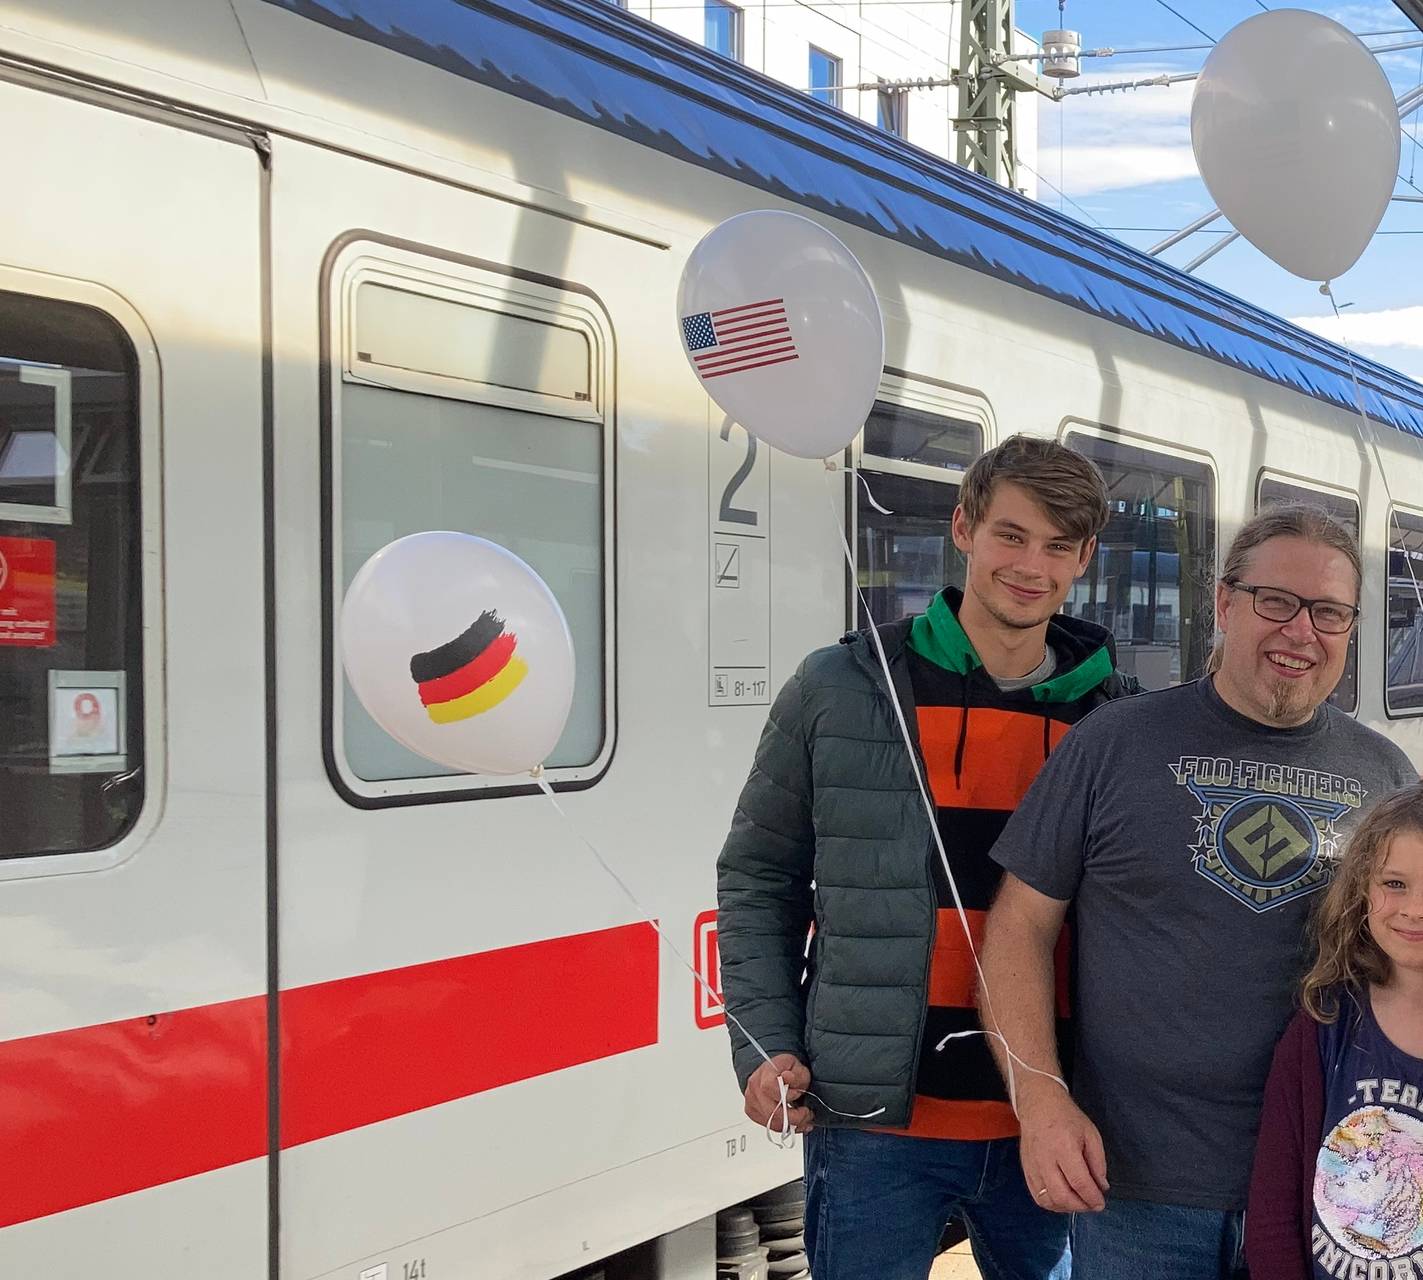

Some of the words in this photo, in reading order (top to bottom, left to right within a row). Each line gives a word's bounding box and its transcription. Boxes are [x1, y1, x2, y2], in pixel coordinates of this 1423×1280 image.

[719, 415, 757, 526] 2
[1176, 756, 1233, 786] FOO
[1238, 759, 1362, 808] FIGHTERS
